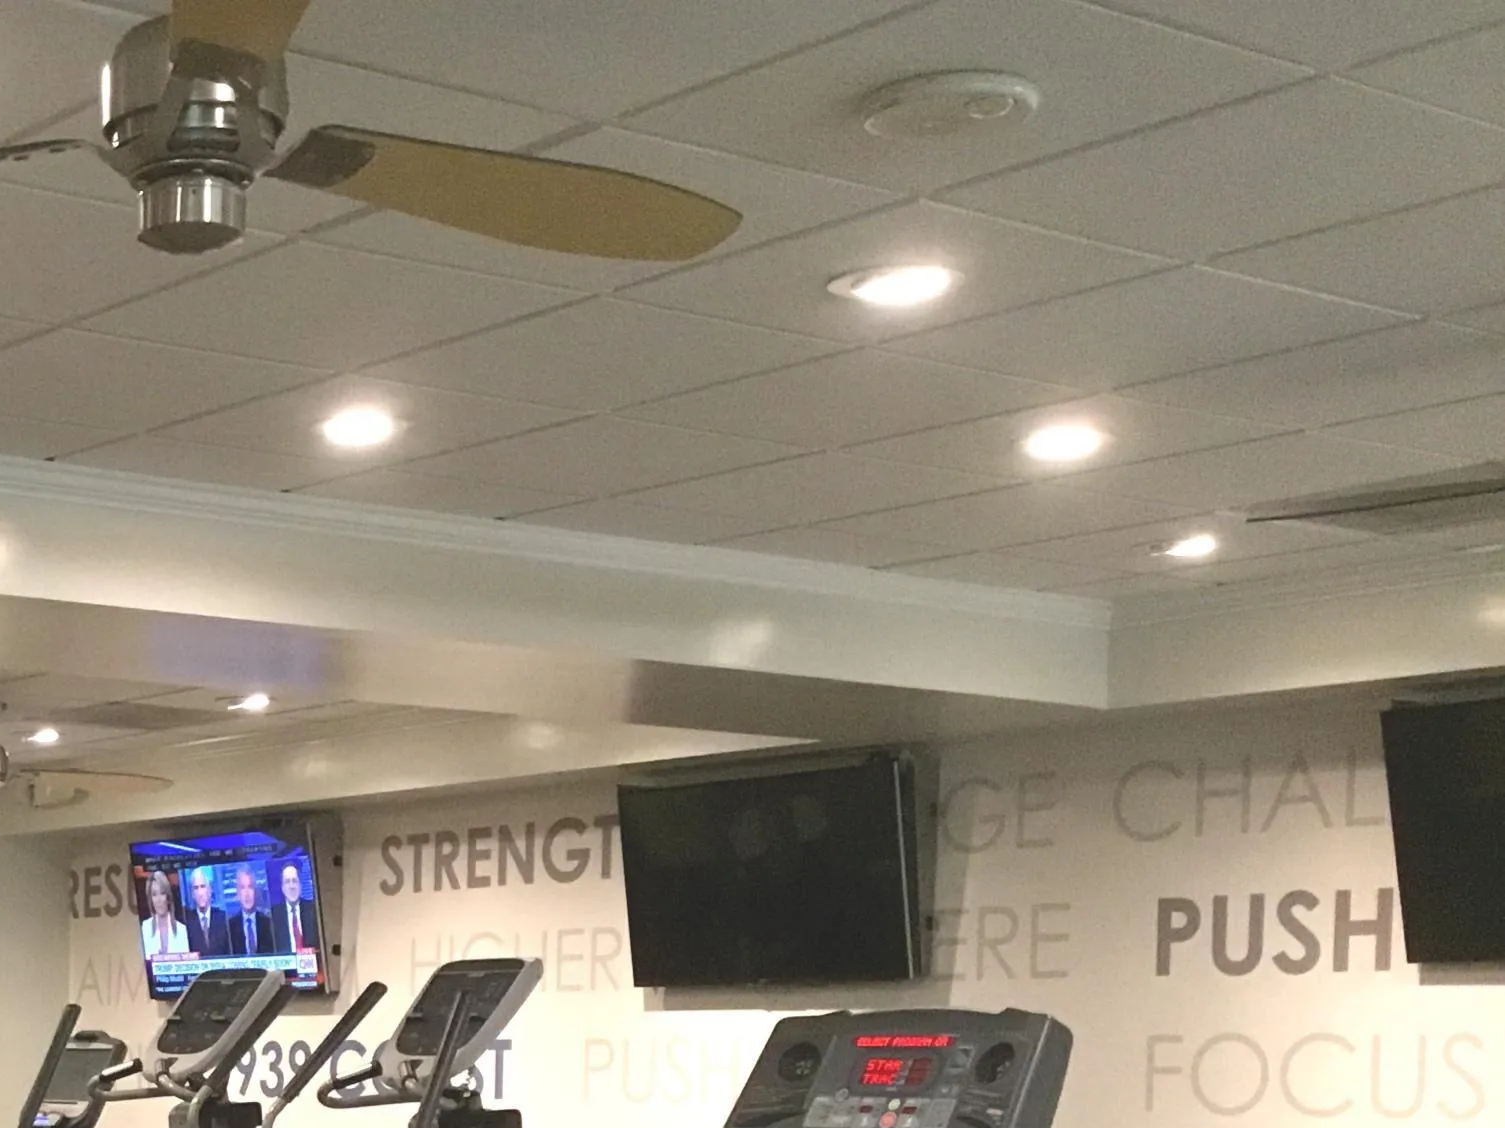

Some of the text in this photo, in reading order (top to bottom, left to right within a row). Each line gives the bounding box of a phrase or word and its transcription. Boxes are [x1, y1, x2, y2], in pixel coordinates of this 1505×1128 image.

[1112, 746, 1388, 844] CHAL
[379, 814, 621, 897] STRENGT
[1154, 886, 1395, 978] PUSH
[1144, 1031, 1487, 1120] FOCUS
